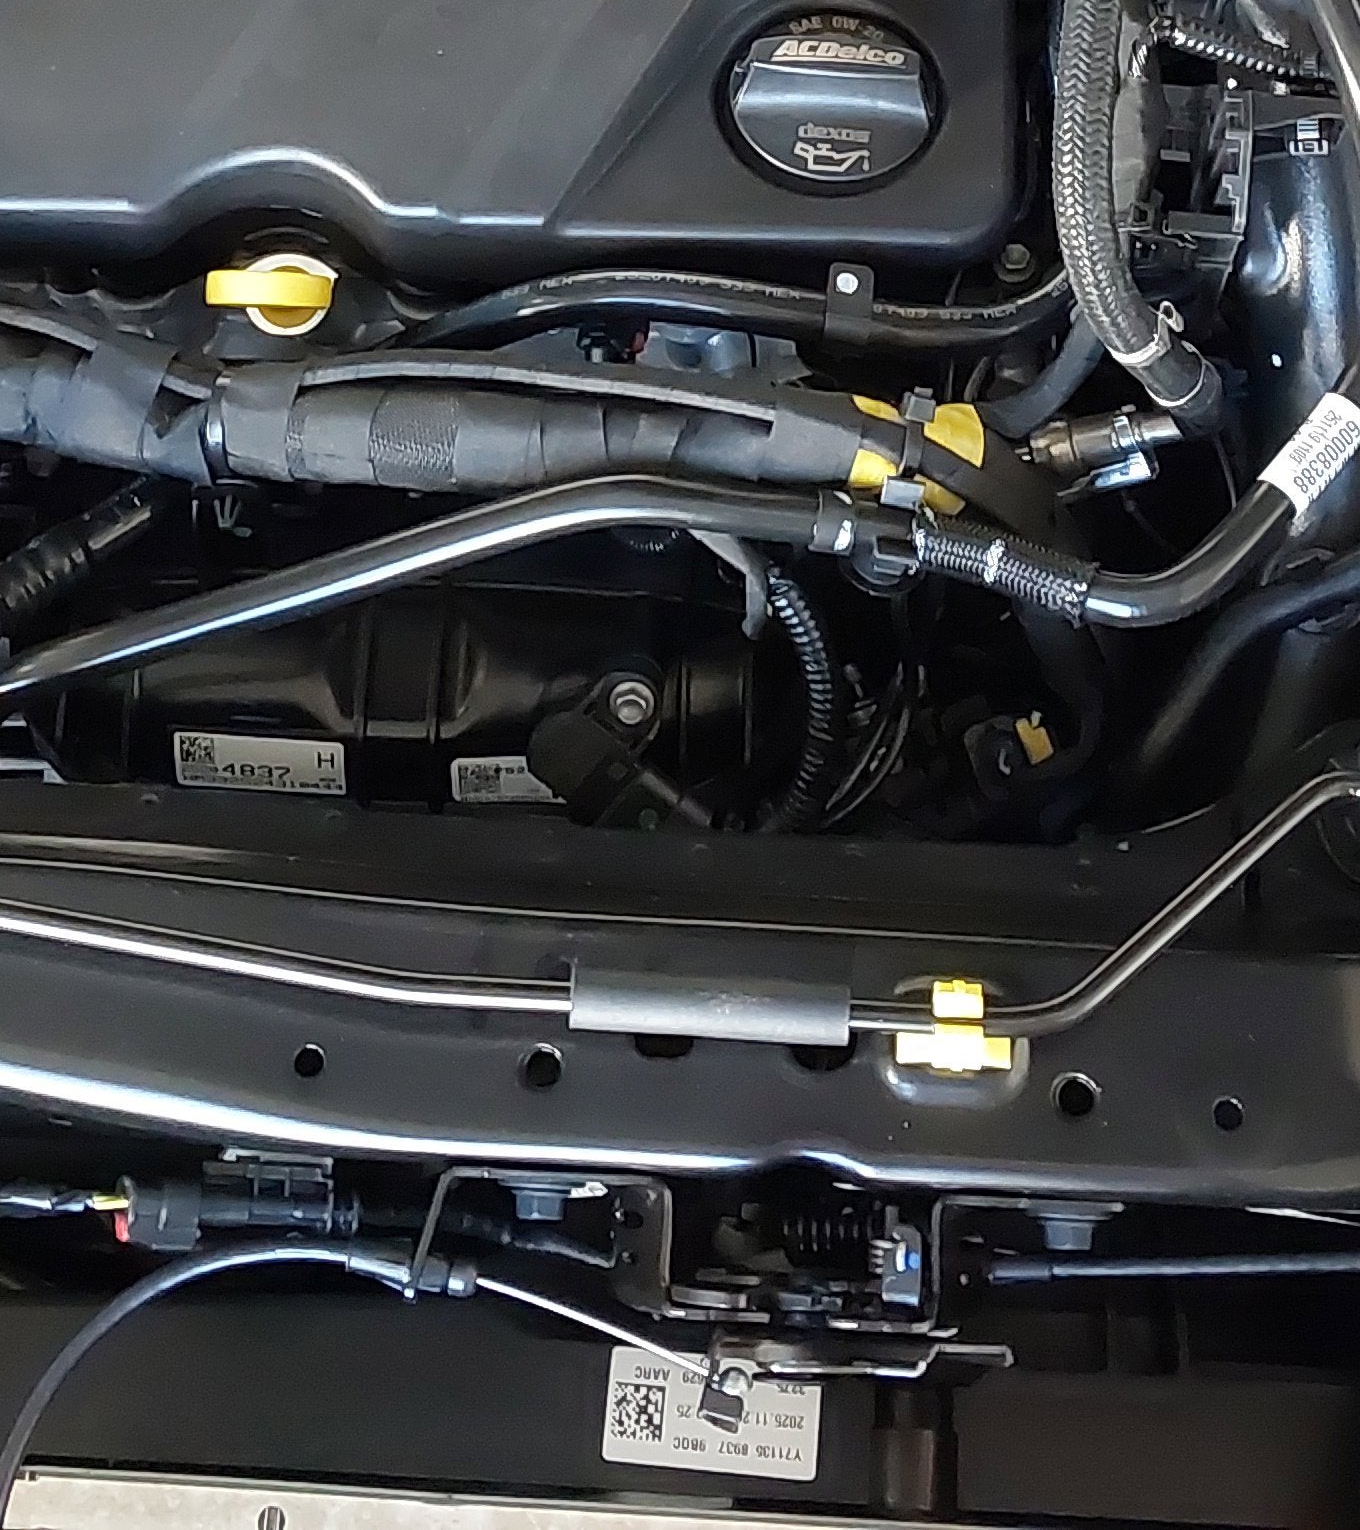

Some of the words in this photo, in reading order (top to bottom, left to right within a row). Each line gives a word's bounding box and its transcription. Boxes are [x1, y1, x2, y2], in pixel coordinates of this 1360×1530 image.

[789, 16, 823, 35] SAE
[774, 39, 906, 66] ACDelco
[1293, 420, 1360, 494] 60008388
[317, 751, 335, 769] H
